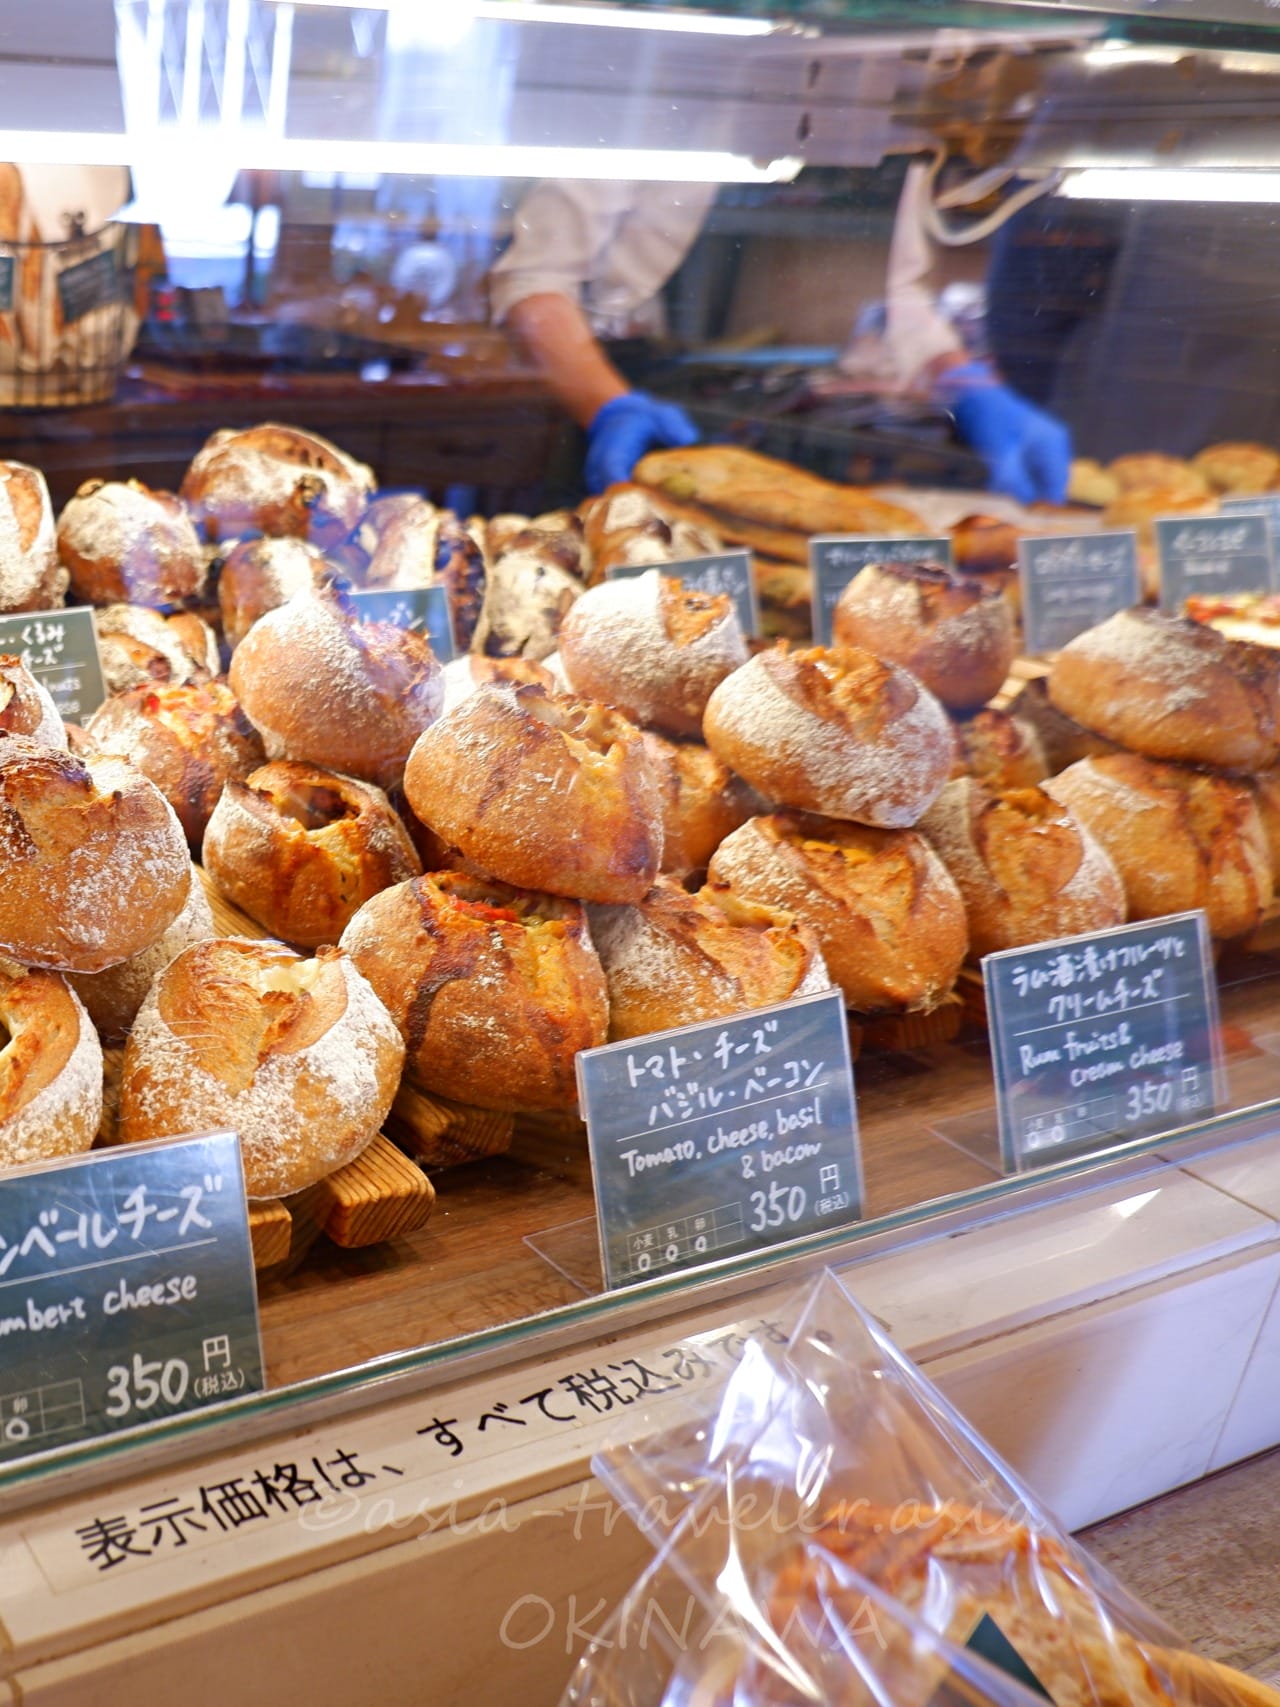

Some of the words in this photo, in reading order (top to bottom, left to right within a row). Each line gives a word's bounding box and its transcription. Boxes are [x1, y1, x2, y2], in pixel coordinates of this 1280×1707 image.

[1047, 967, 1165, 1022] クリームチーズ
[775, 1096, 824, 1137] basil
[1125, 1080, 1172, 1121] 350
[1181, 1066, 1200, 1093] 円
[740, 1154, 757, 1179] &
[749, 1180, 808, 1232] 350
[819, 1163, 841, 1194] 円
[102, 1273, 199, 1316] cheese
[104, 1352, 190, 1418] 350
[201, 1334, 232, 1372] 円
[192, 1368, 246, 1399] (税込)
